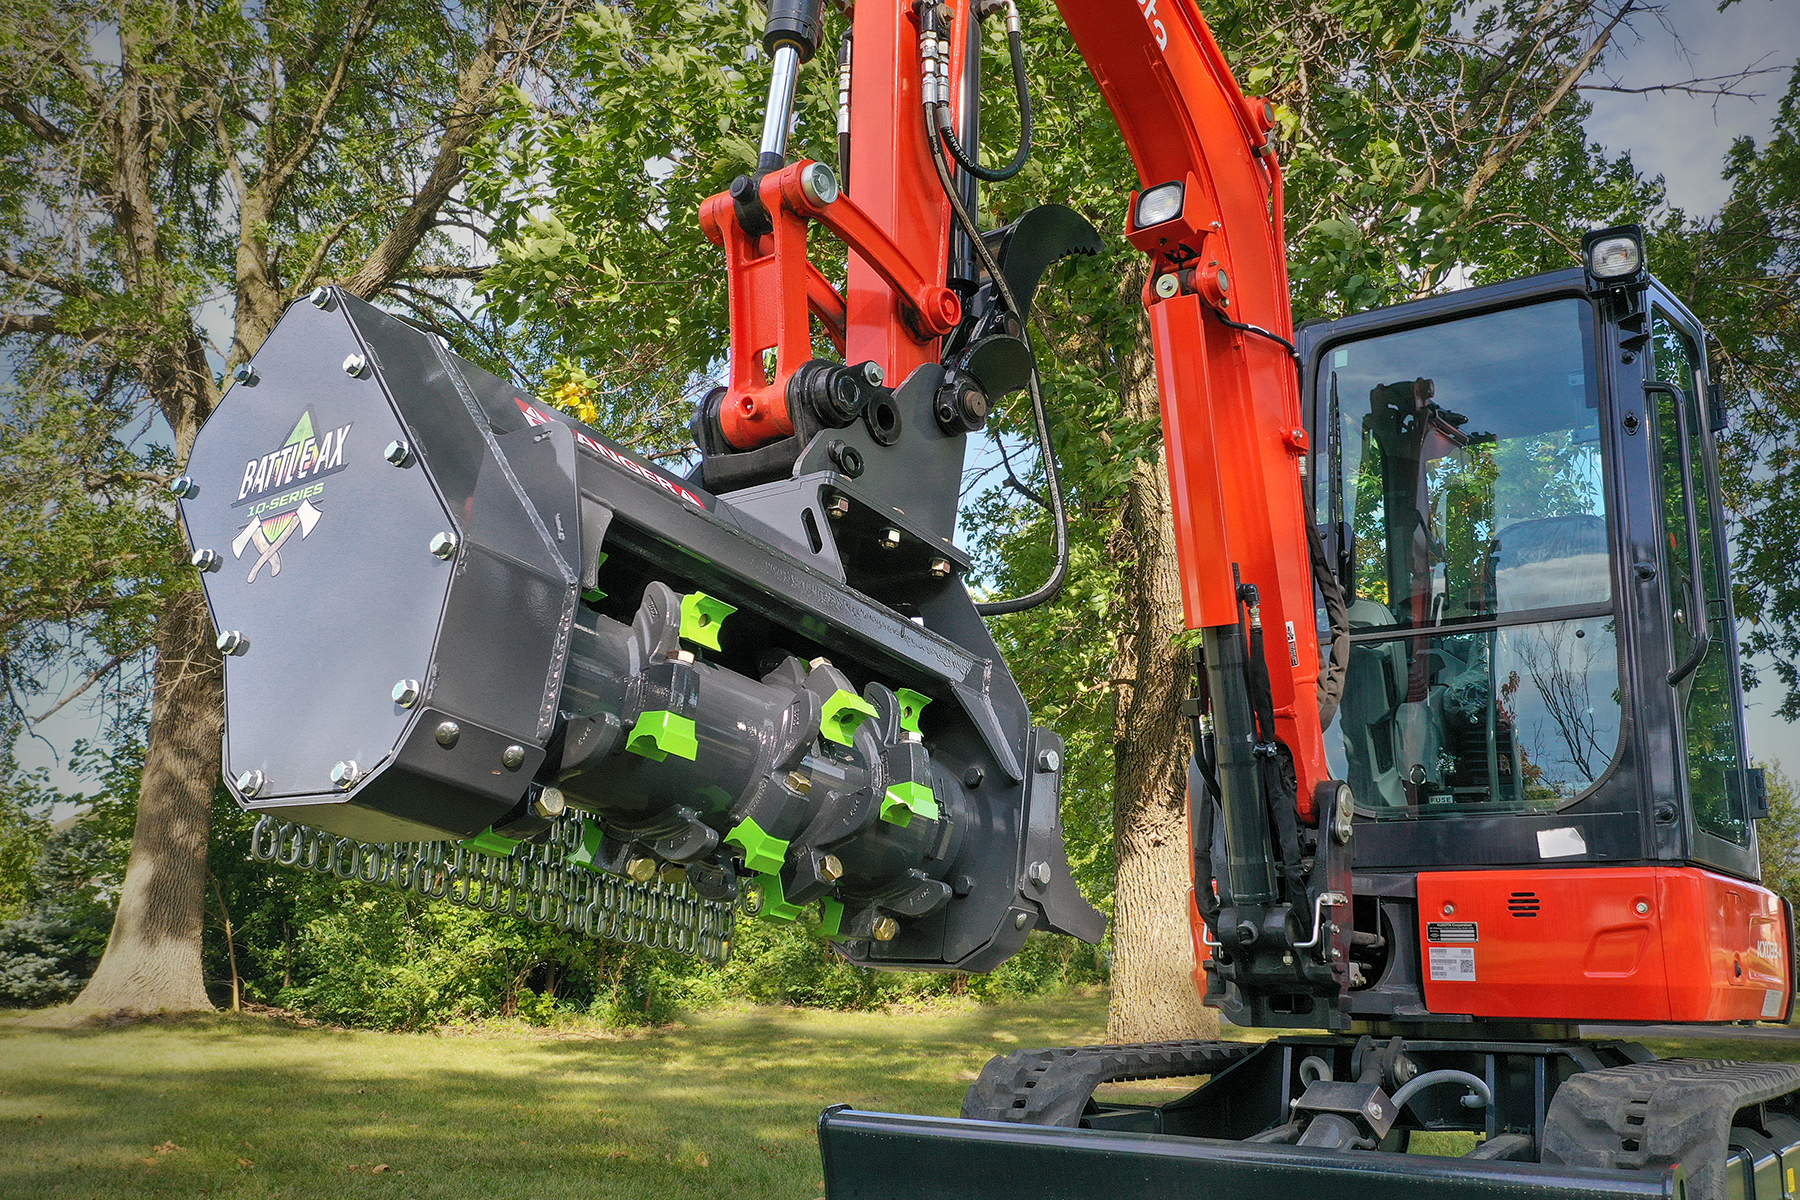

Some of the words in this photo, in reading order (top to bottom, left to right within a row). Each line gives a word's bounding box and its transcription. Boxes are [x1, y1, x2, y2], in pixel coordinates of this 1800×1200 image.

[949, 137, 962, 151] BAR
[238, 438, 316, 500] BATTLE
[312, 423, 353, 474] AX
[247, 482, 325, 517] 10-SERIES
